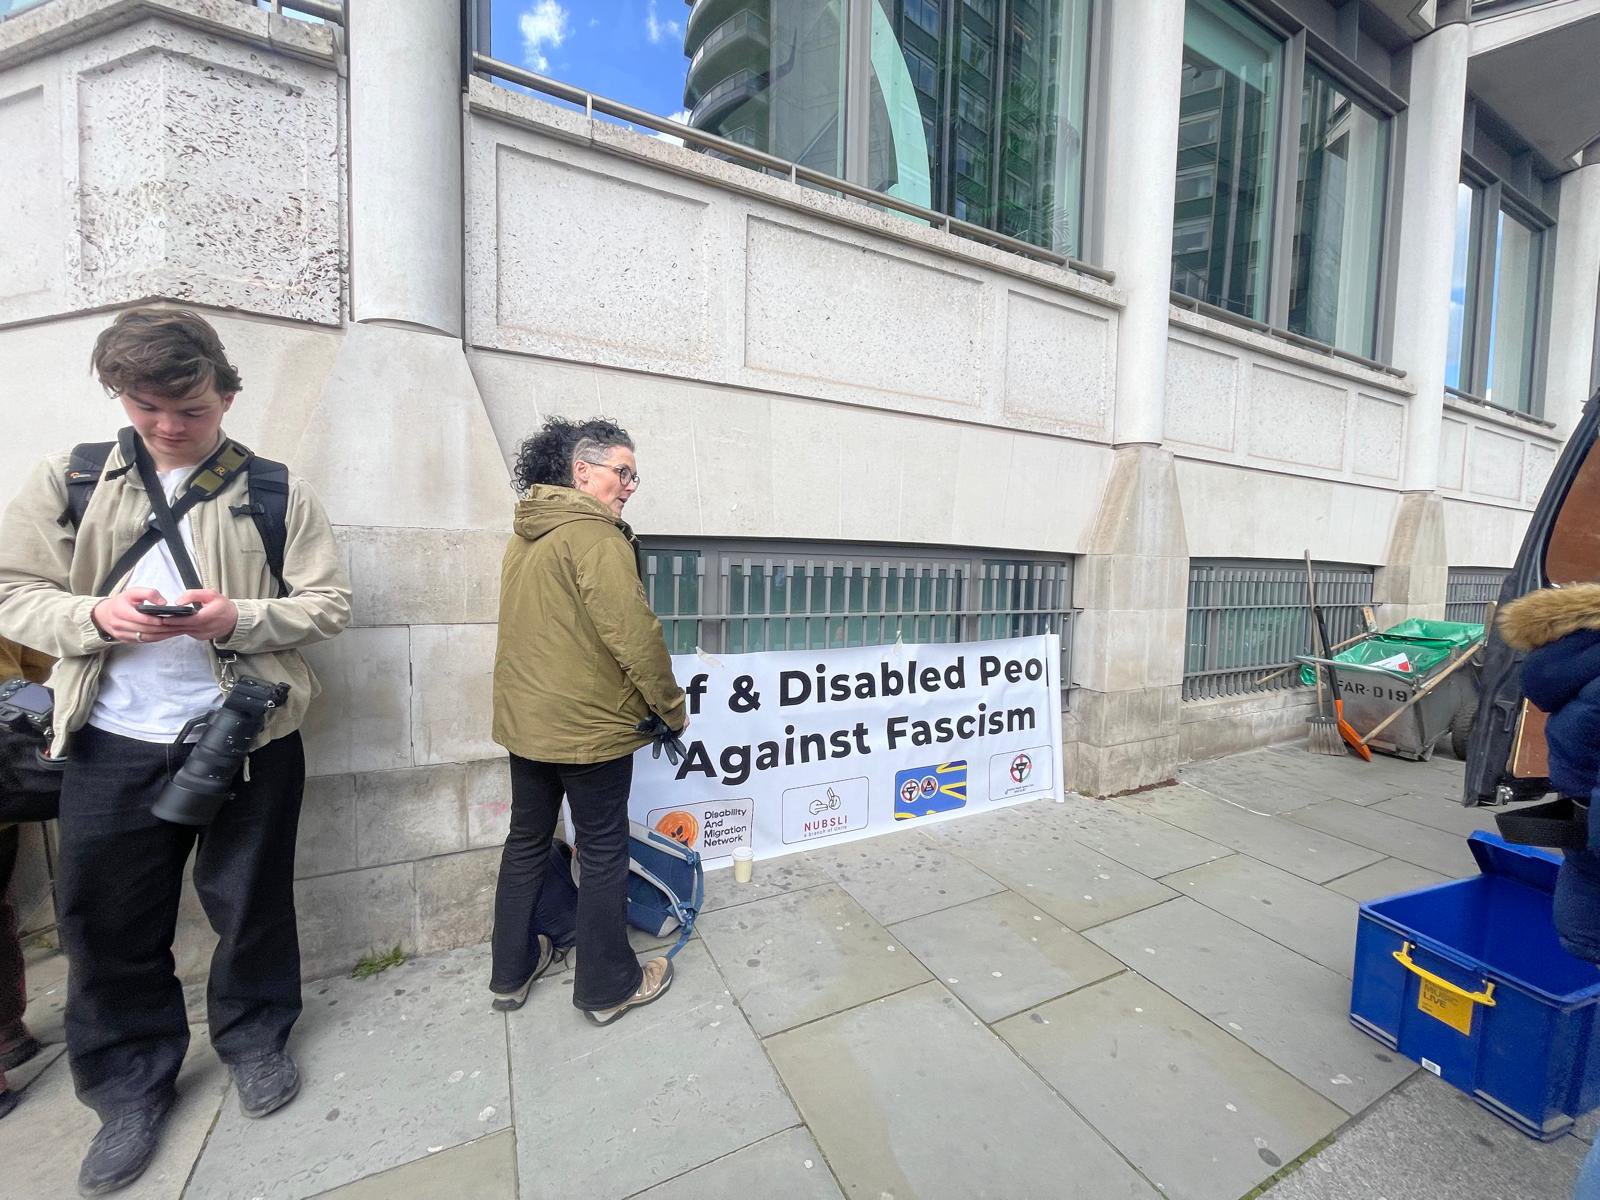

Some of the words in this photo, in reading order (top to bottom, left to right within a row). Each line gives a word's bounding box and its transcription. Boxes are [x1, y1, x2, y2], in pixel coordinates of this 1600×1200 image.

[728, 675, 761, 713] &
[780, 656, 965, 706] Disabled
[980, 656, 1049, 687] Peo
[675, 723, 872, 786] Against
[887, 703, 1036, 750] Fascism
[704, 808, 747, 820] Disability
[704, 819, 724, 830] And
[804, 815, 848, 832] NUBSLI
[704, 824, 747, 839] Migration
[704, 834, 743, 848] Network
